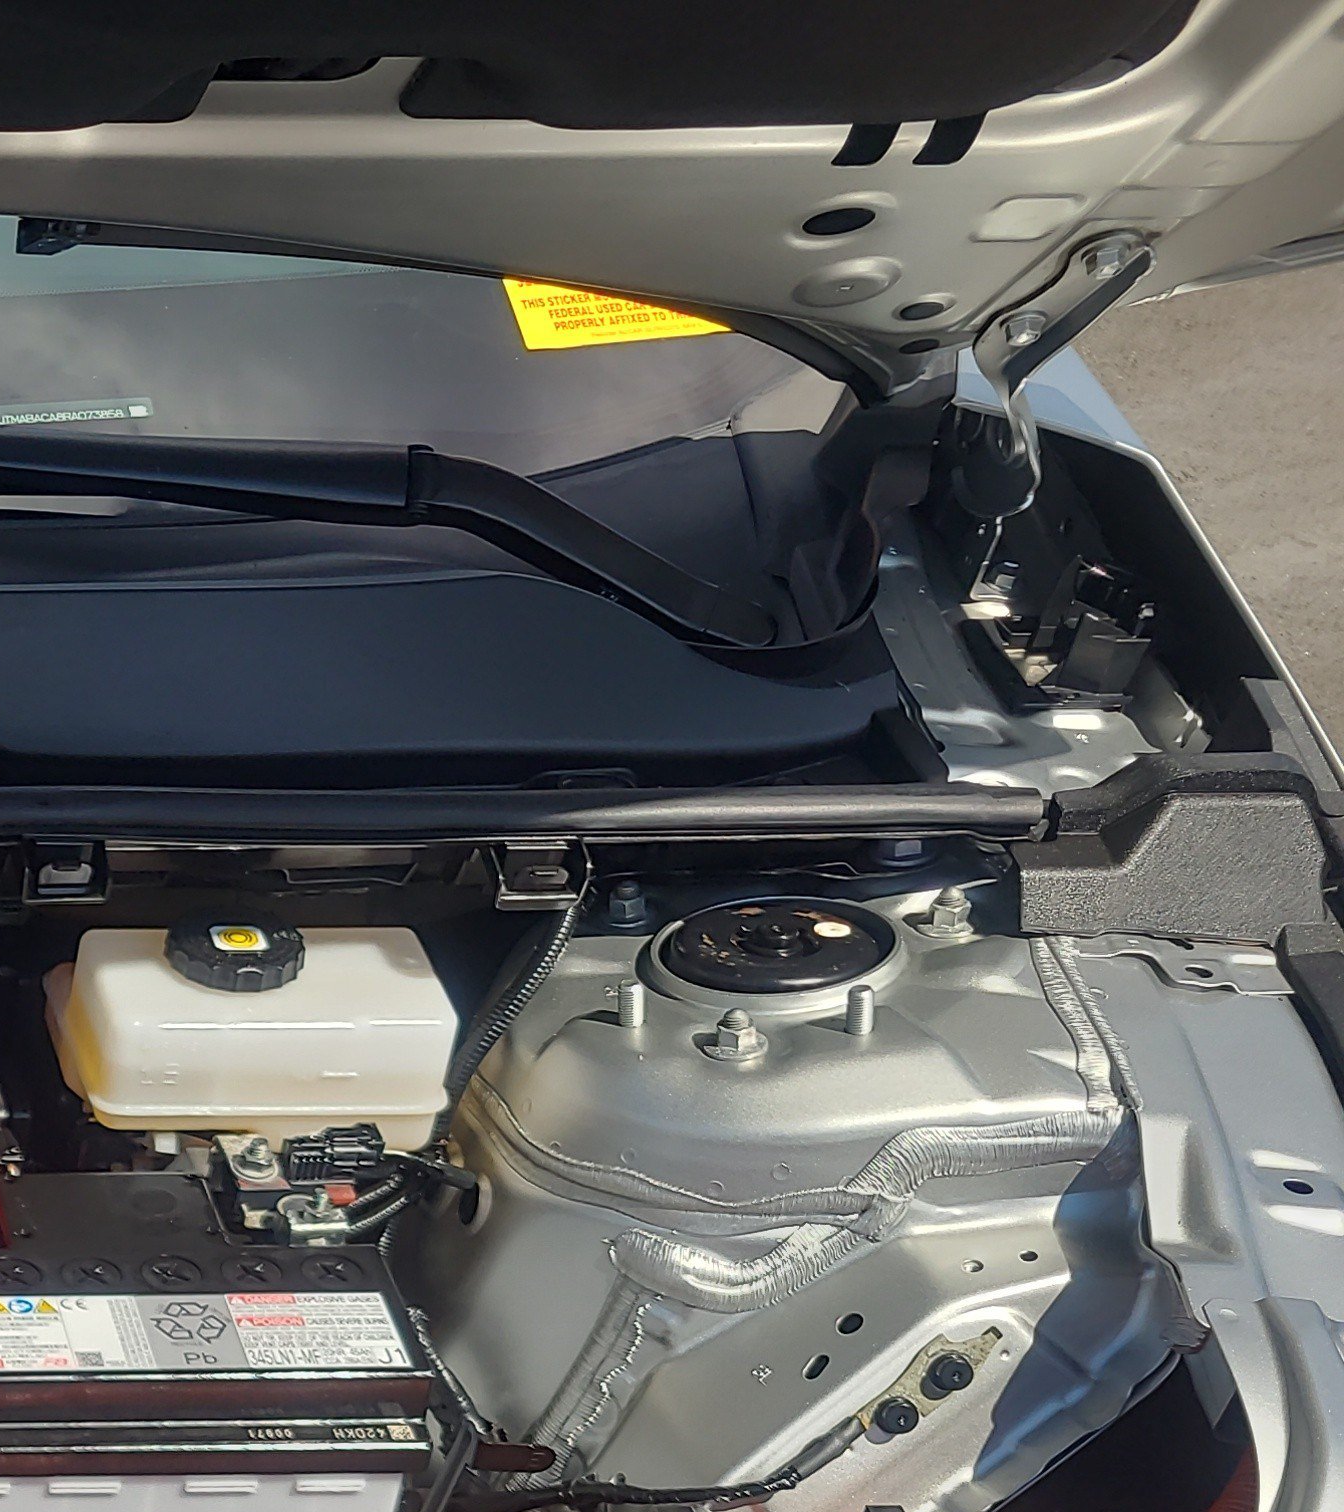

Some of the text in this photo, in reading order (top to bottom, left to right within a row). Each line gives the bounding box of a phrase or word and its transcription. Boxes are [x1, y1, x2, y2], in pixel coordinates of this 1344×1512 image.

[521, 299, 546, 309] THIS
[547, 293, 593, 307] STICKER
[548, 306, 595, 319] FEDERAL
[596, 302, 623, 314] USED
[553, 318, 606, 331] PROPERLY
[608, 314, 651, 326] AFFIXED
[653, 312, 667, 322] TO
[297, 1295, 346, 1303] EXPLOSIVE
[349, 1295, 380, 1303] GASES
[253, 1317, 304, 1326] POISON
[183, 1352, 217, 1365] Pb
[249, 1348, 321, 1365] 345LN1-MF
[378, 1348, 407, 1365] J1
